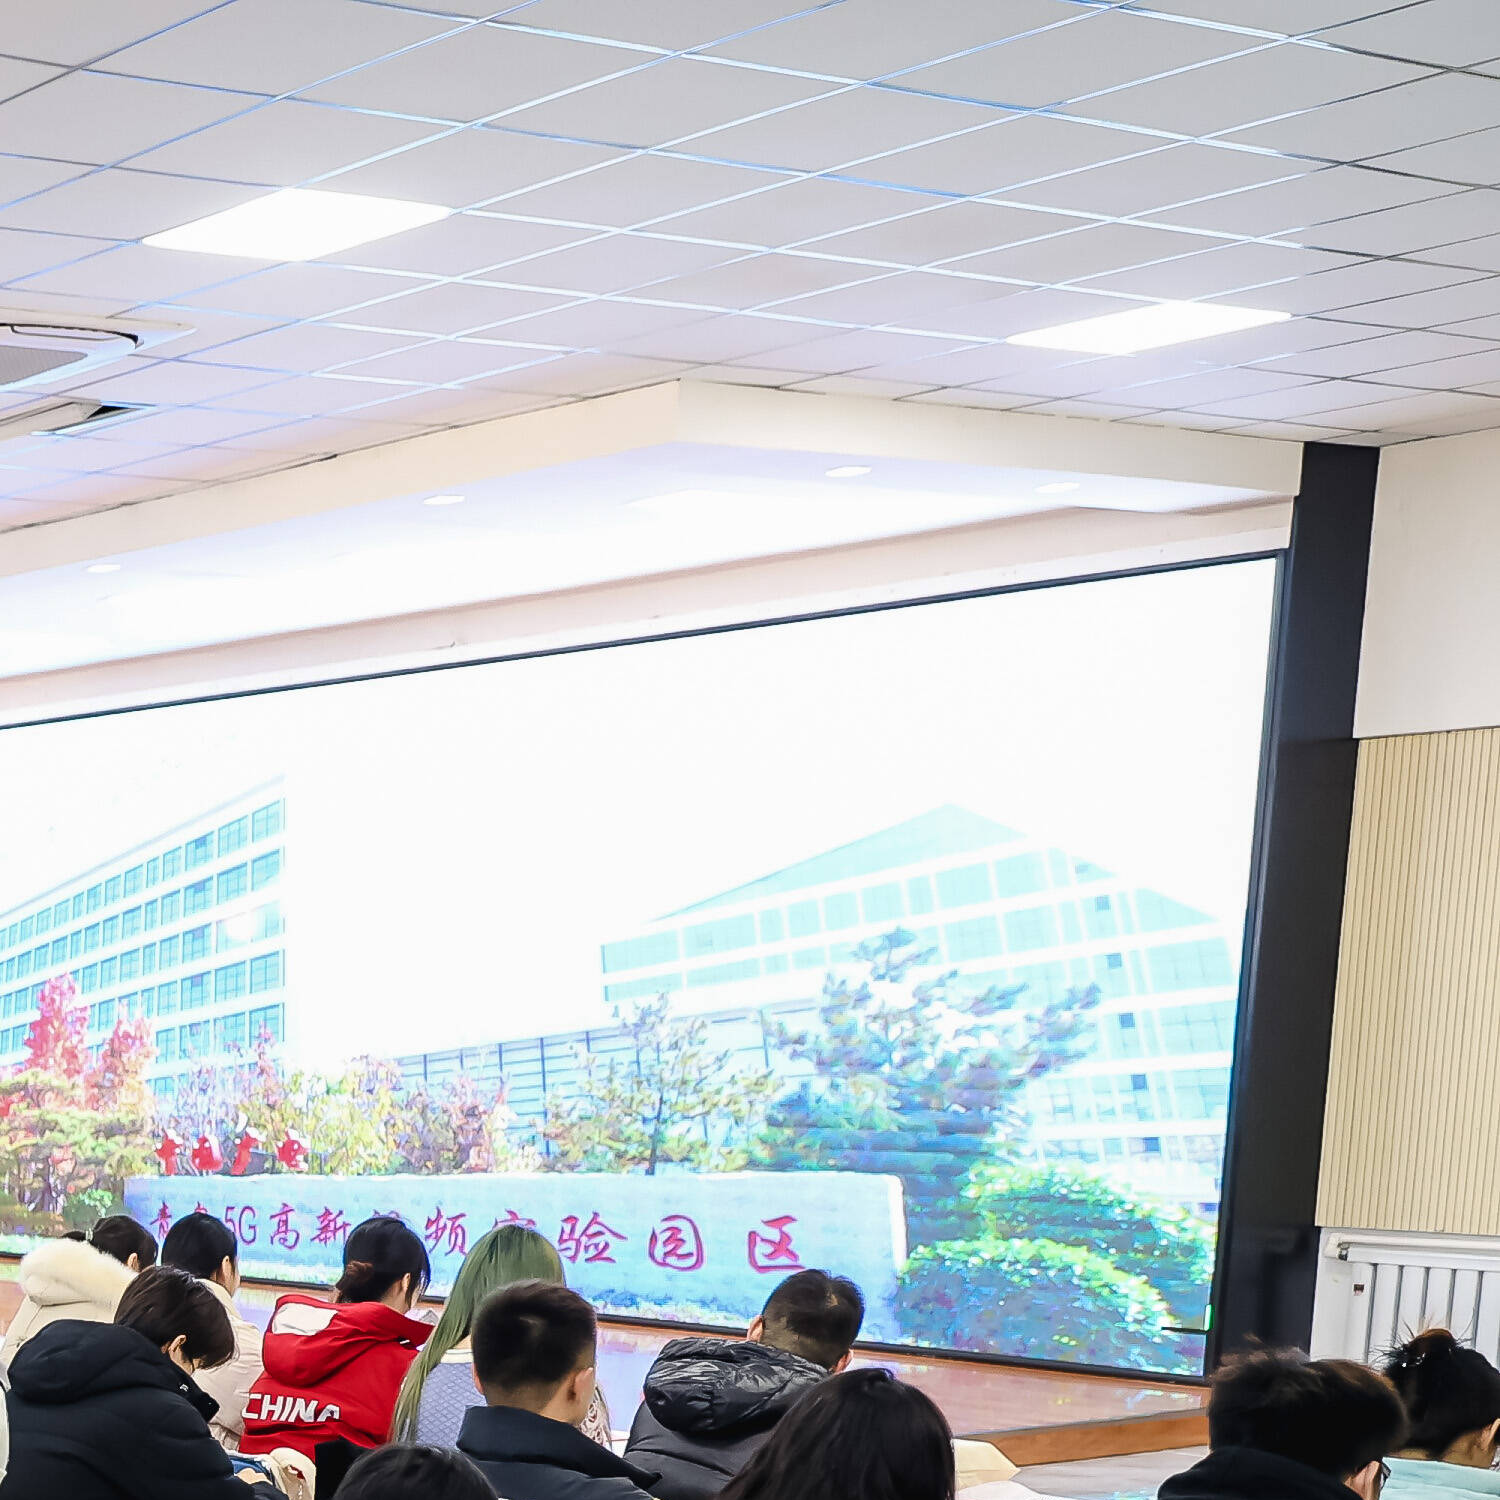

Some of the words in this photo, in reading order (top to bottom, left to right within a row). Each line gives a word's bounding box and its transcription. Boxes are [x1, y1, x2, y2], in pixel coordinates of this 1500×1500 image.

[150, 1200, 806, 1274] 青5G高新频验园区
[241, 1393, 340, 1423] CHINA
